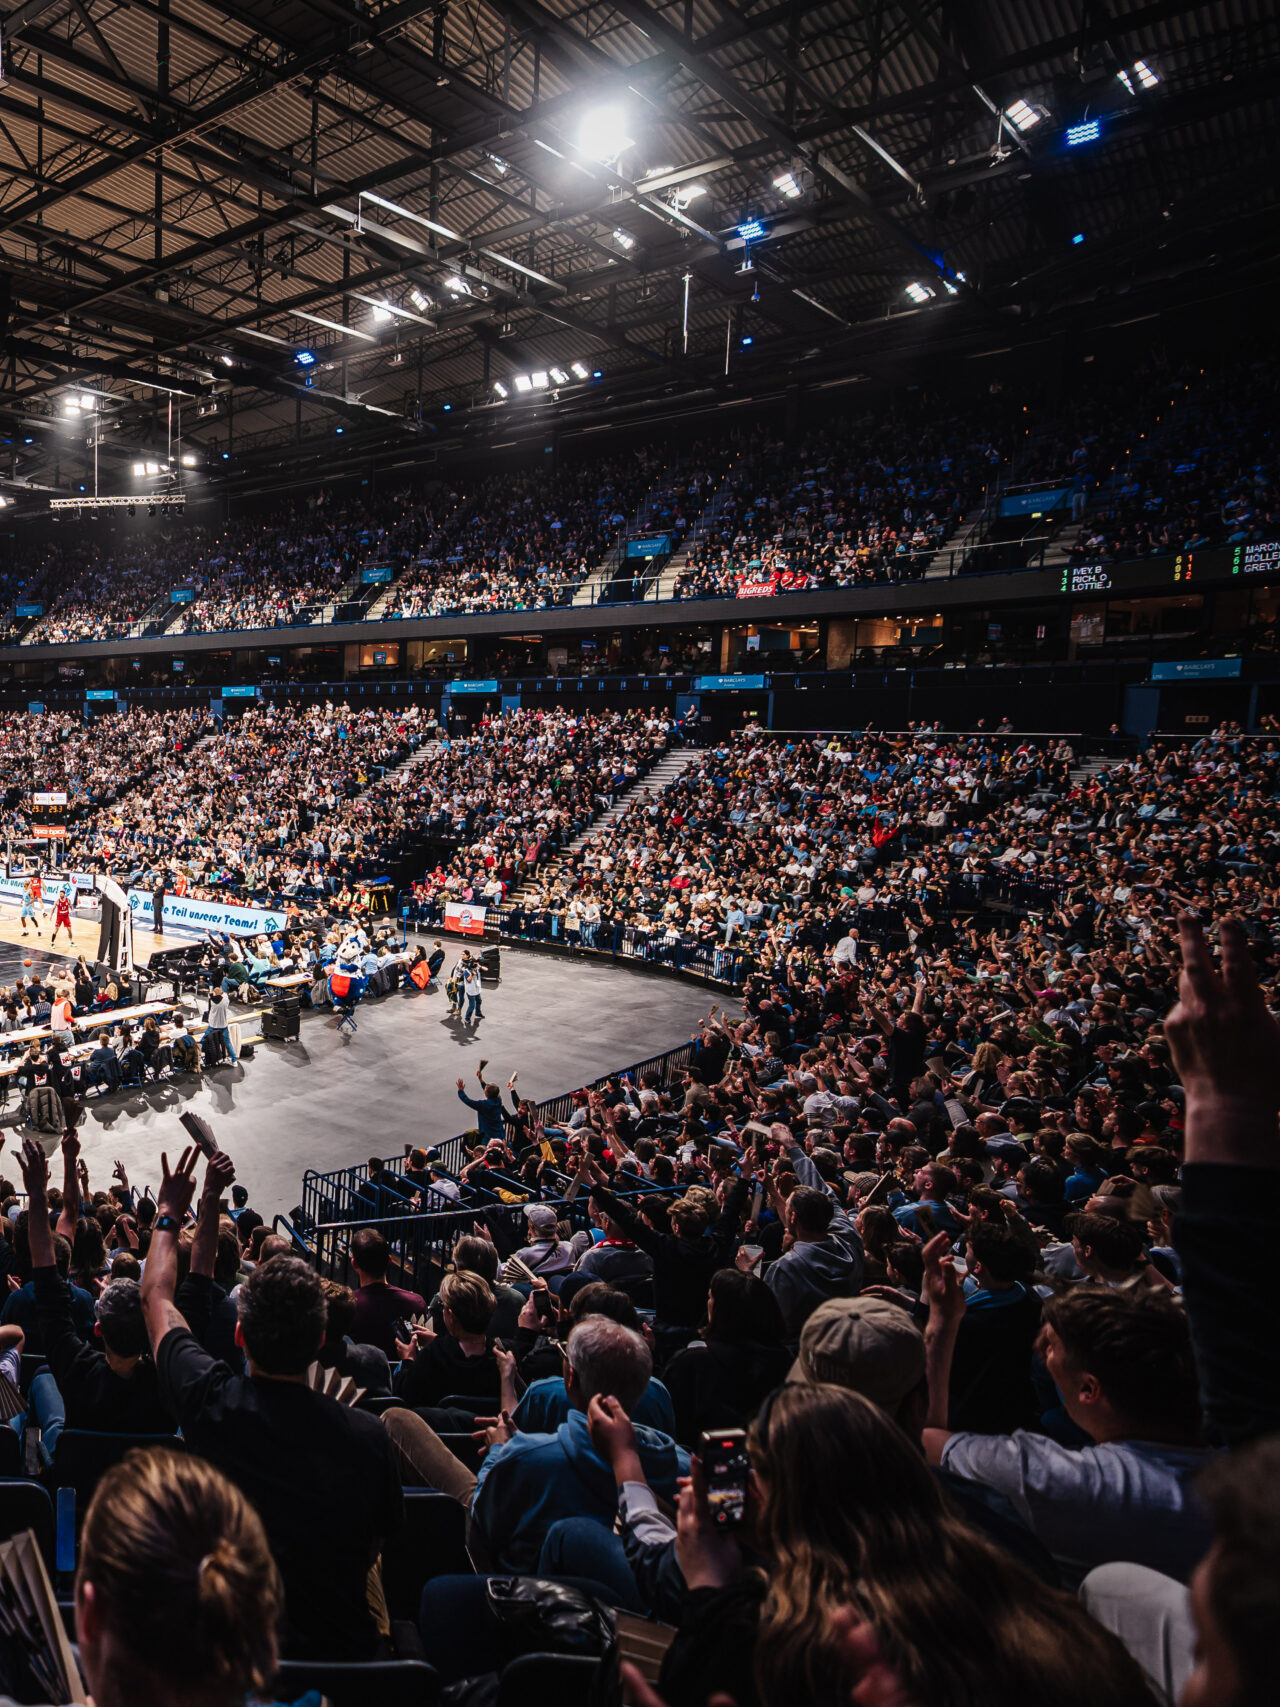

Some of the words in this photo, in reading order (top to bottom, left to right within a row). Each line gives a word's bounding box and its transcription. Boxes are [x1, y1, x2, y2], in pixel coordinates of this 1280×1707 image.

[1234, 547, 1241, 555] 5
[1245, 552, 1280, 563] MÖLLE
[171, 905, 187, 917] Teil
[189, 911, 221, 924] unseres
[224, 915, 258, 929] Teams!
